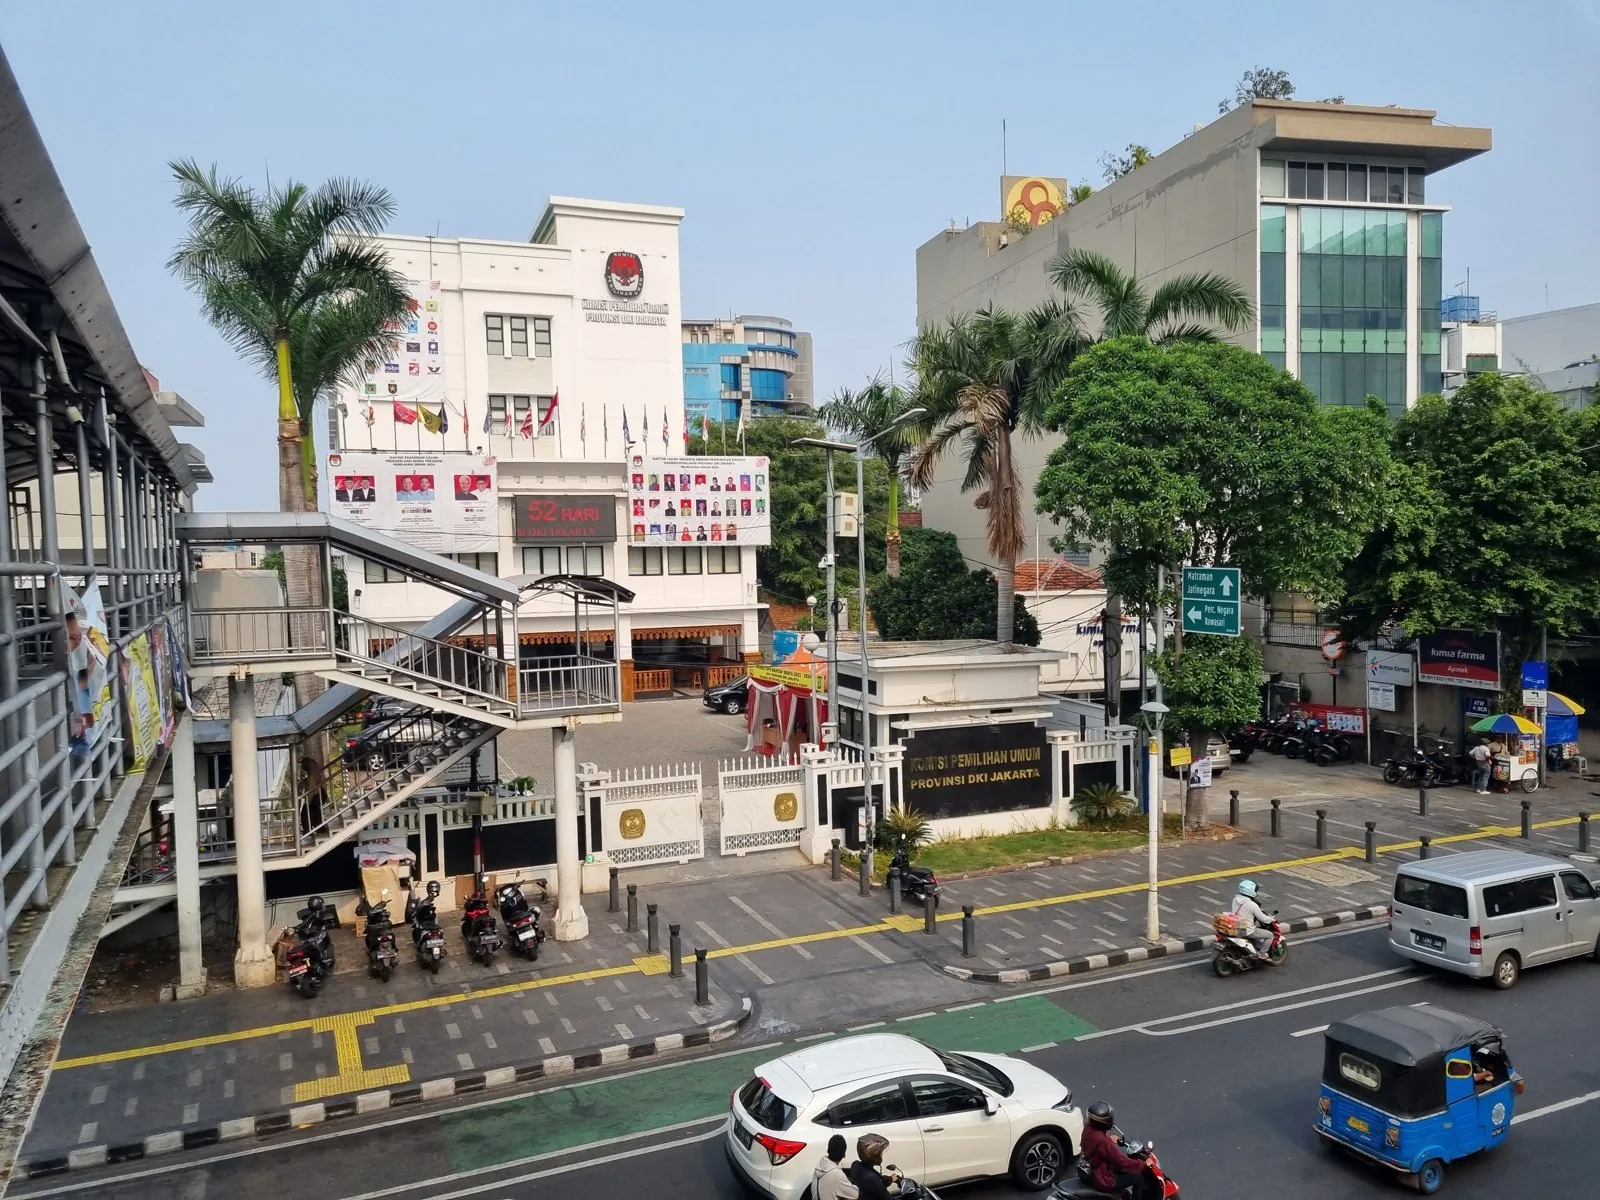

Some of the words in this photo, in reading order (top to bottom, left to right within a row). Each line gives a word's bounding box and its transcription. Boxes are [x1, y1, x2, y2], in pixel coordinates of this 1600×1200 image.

[582, 300, 608, 310] KOMISI
[610, 301, 646, 313] PEMILIHAN
[647, 303, 669, 314] UMUM
[586, 313, 620, 324] PROVINSI
[622, 314, 634, 325] DKI
[636, 315, 666, 326] JAKARTA
[528, 500, 557, 521] 52
[561, 507, 600, 521] HARI
[550, 528, 596, 536] JAKARTA
[1187, 571, 1213, 581] Matraman
[1187, 584, 1215, 597] Jatinegara
[1204, 604, 1216, 614] Perc.
[1217, 605, 1234, 616] Negara
[1204, 617, 1226, 627] Rawasari
[1431, 648, 1456, 658] kimia
[1457, 649, 1486, 661] farma
[1447, 666, 1469, 674] Apotek
[910, 756, 948, 772] KOMISI
[951, 750, 1008, 769] PEMILIHAN
[1009, 747, 1041, 764] UMUM
[910, 774, 965, 790] PROVINSI
[968, 773, 988, 784] DKI
[990, 768, 1041, 782] JAKARTA
